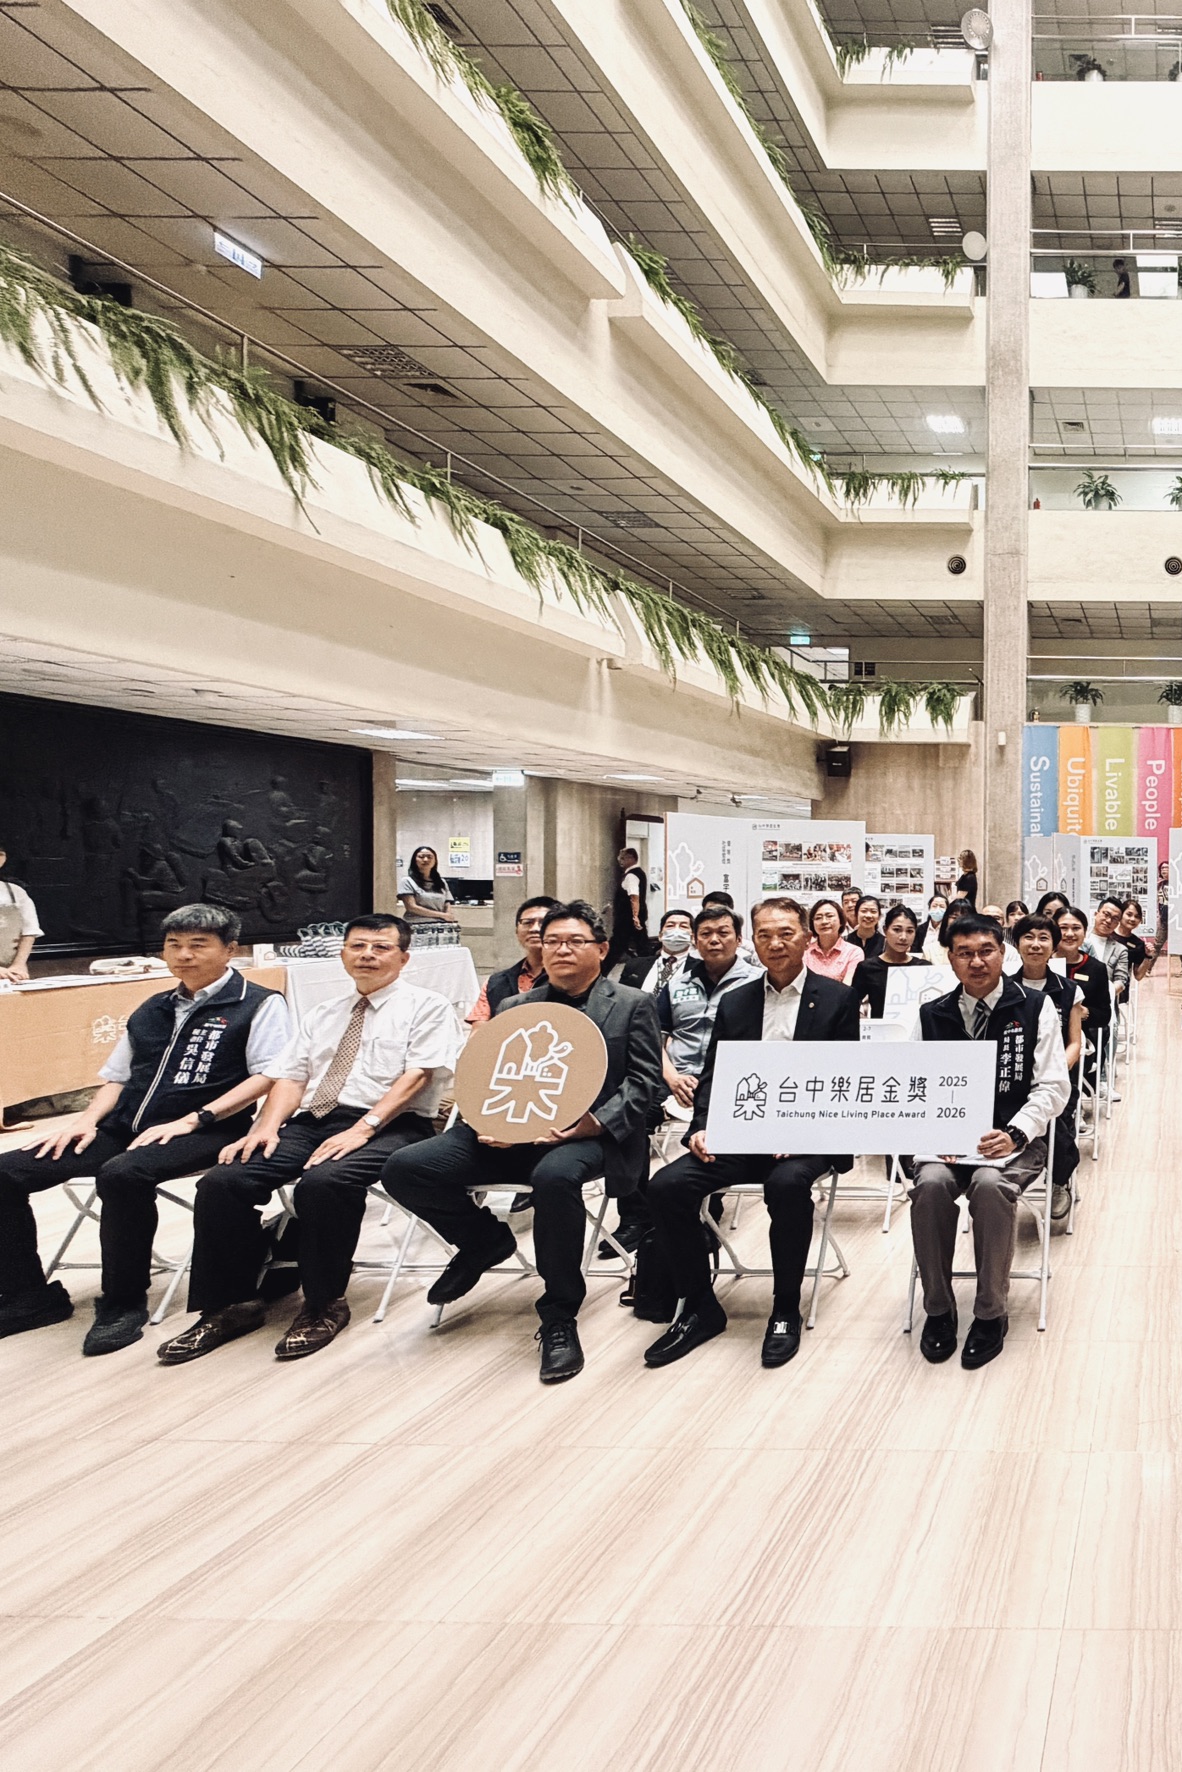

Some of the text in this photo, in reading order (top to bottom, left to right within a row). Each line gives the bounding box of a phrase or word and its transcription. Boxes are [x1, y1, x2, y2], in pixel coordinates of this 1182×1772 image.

[1063, 757, 1086, 834] Ubiquit
[1105, 758, 1125, 831] Livable
[1141, 759, 1166, 830] People
[191, 1029, 223, 1084] 都市發展局
[1013, 1034, 1025, 1082] 都市發展局
[778, 1075, 928, 1103] 台中樂居金獎
[938, 1075, 968, 1087] 2025
[776, 1110, 926, 1120] Taichung Nice Living Place Award
[936, 1107, 966, 1119] 2026
